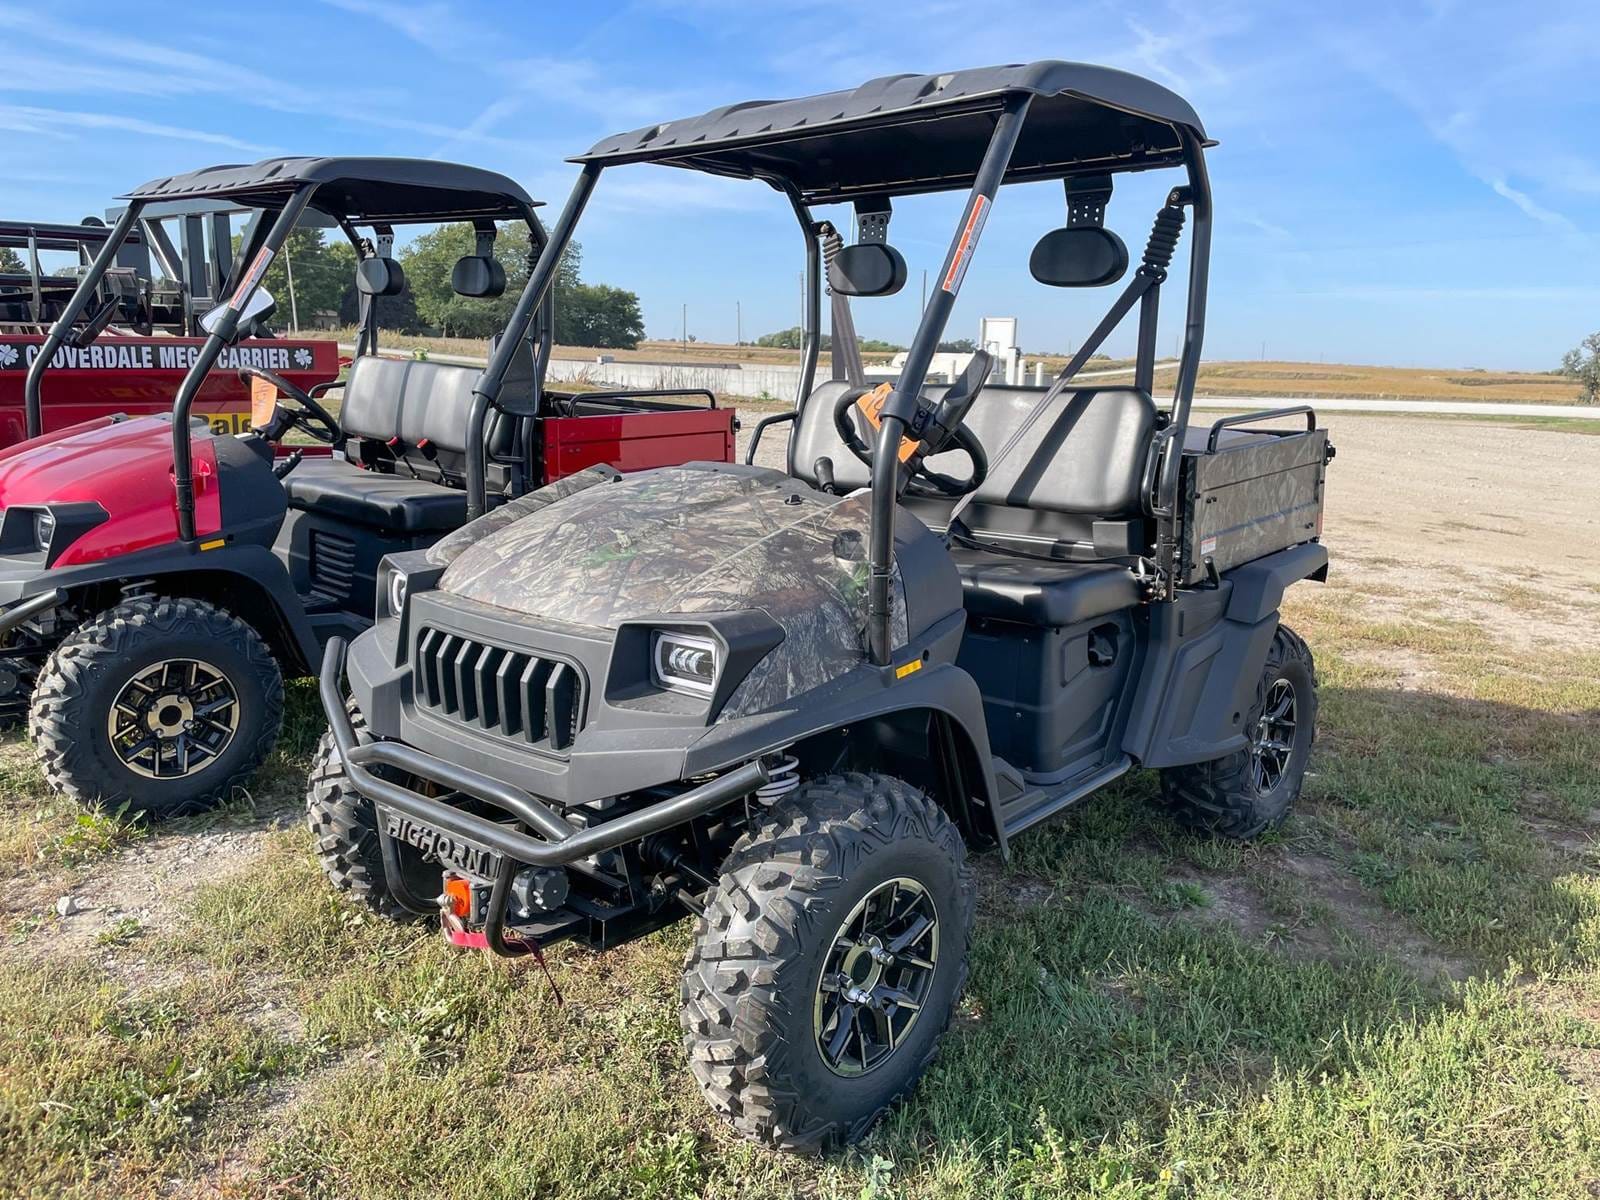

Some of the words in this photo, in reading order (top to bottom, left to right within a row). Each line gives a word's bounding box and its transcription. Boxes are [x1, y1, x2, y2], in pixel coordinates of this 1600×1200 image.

[26, 345, 153, 369] COVERDALE
[159, 347, 201, 369] MEG
[218, 348, 290, 369] CARRIER
[387, 815, 484, 876] BIGHORN
